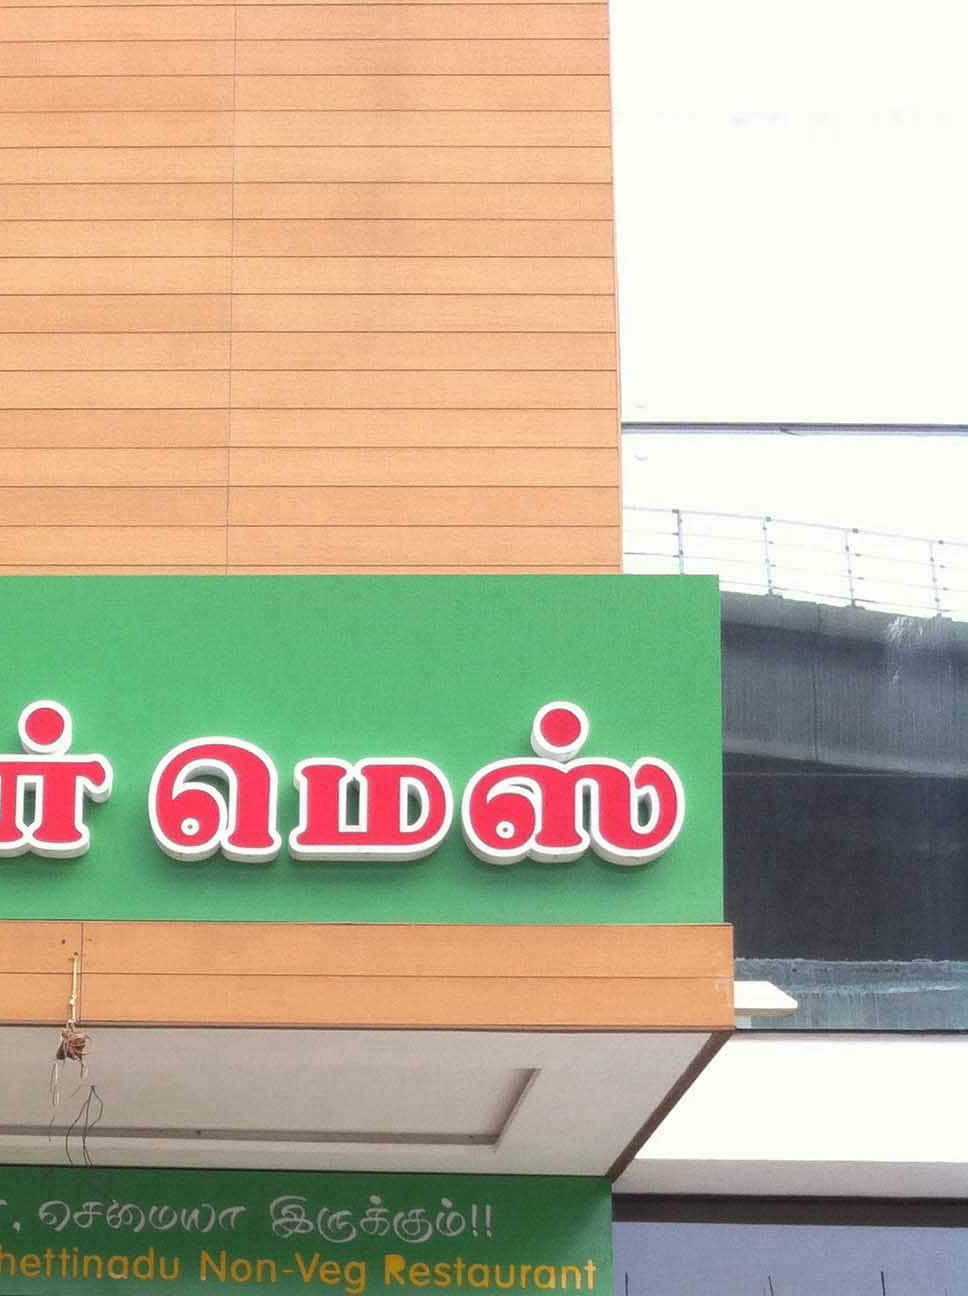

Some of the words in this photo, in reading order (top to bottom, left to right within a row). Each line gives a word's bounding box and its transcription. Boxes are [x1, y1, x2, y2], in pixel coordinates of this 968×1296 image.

[149, 701, 686, 866] மெஸ்
[269, 1194, 494, 1243] இருக்கும்!!
[199, 1250, 368, 1295] Non-Veg
[384, 1254, 598, 1291] Restaurant
